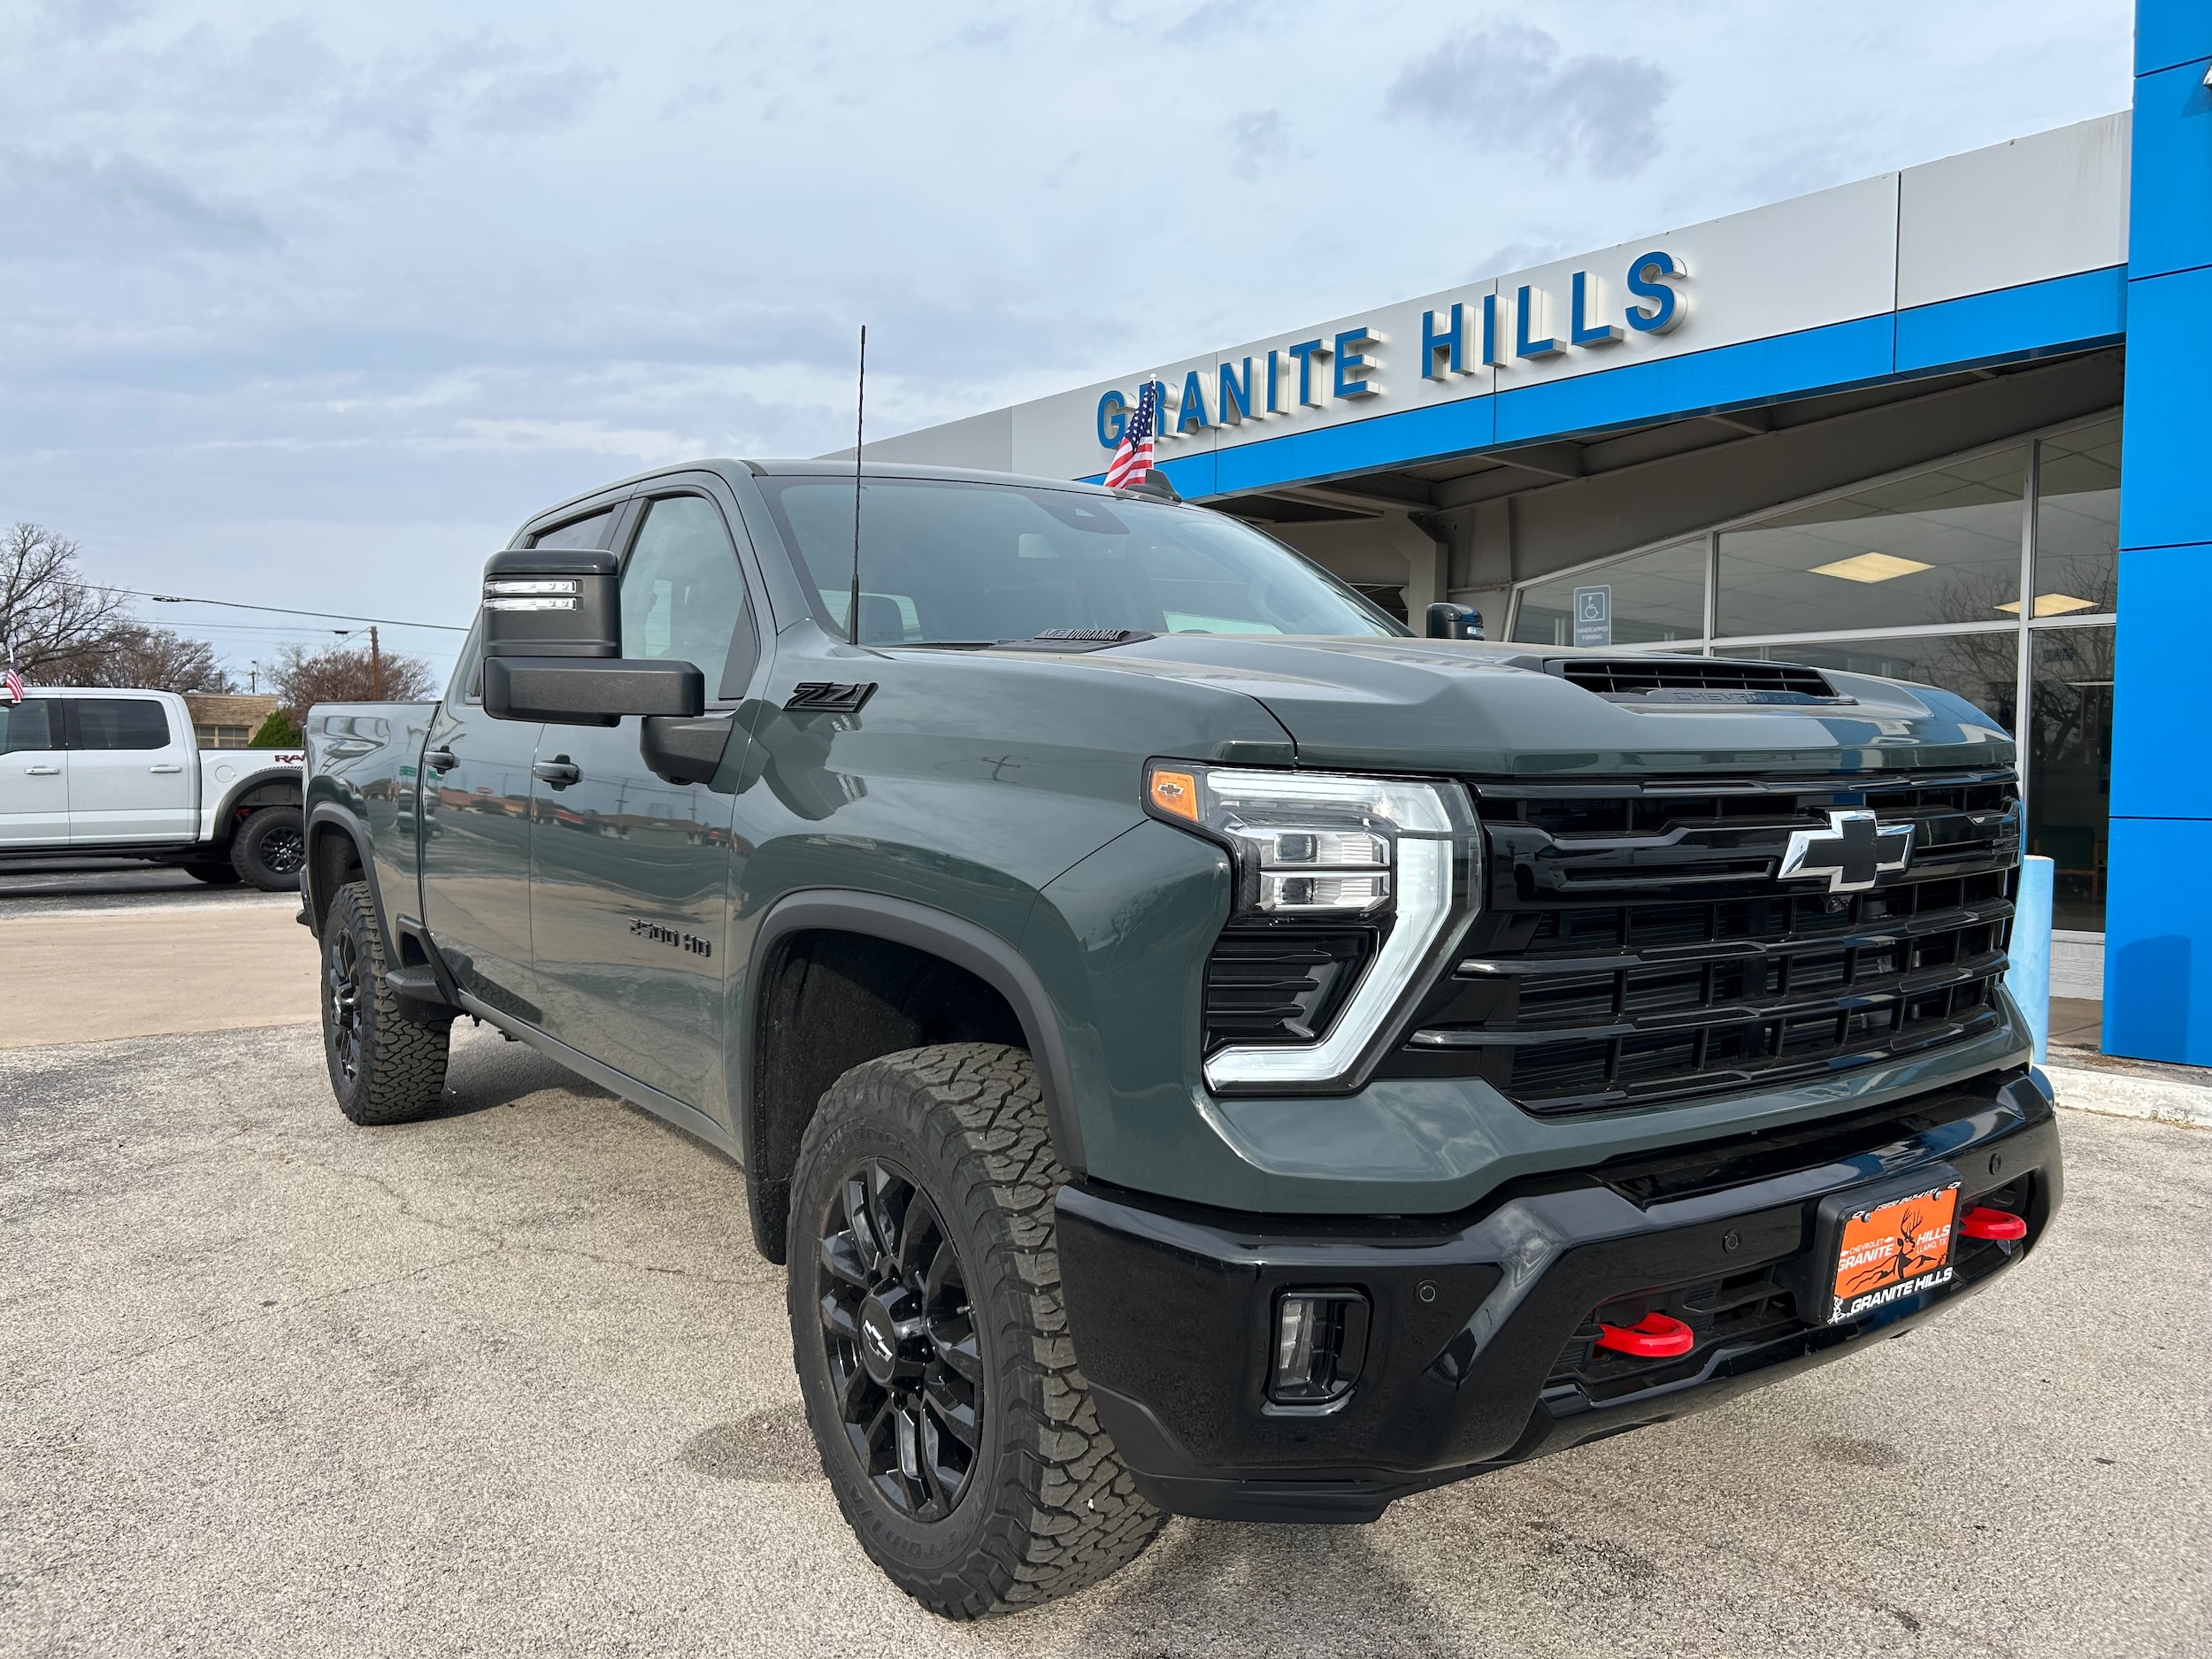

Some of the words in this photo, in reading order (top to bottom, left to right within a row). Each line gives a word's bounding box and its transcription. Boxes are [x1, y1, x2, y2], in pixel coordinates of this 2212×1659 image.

[1097, 326, 1379, 449] GRANITE
[1421, 250, 1688, 381] HILLS
[1067, 629, 1125, 641] DURAMAX
[782, 681, 879, 713] Z71
[1673, 692, 1798, 704] CHEVROLET
[628, 917, 680, 947] 2500
[683, 933, 711, 957] HD
[1838, 1243, 1894, 1272] GRANITE
[1916, 1224, 1951, 1246] HILLS
[1849, 1238, 1884, 1255] CHEVROLET
[1916, 1241, 1937, 1255] LLANO,
[1851, 1278, 1915, 1313] GRANITE
[1914, 1267, 1953, 1292] HILLS
